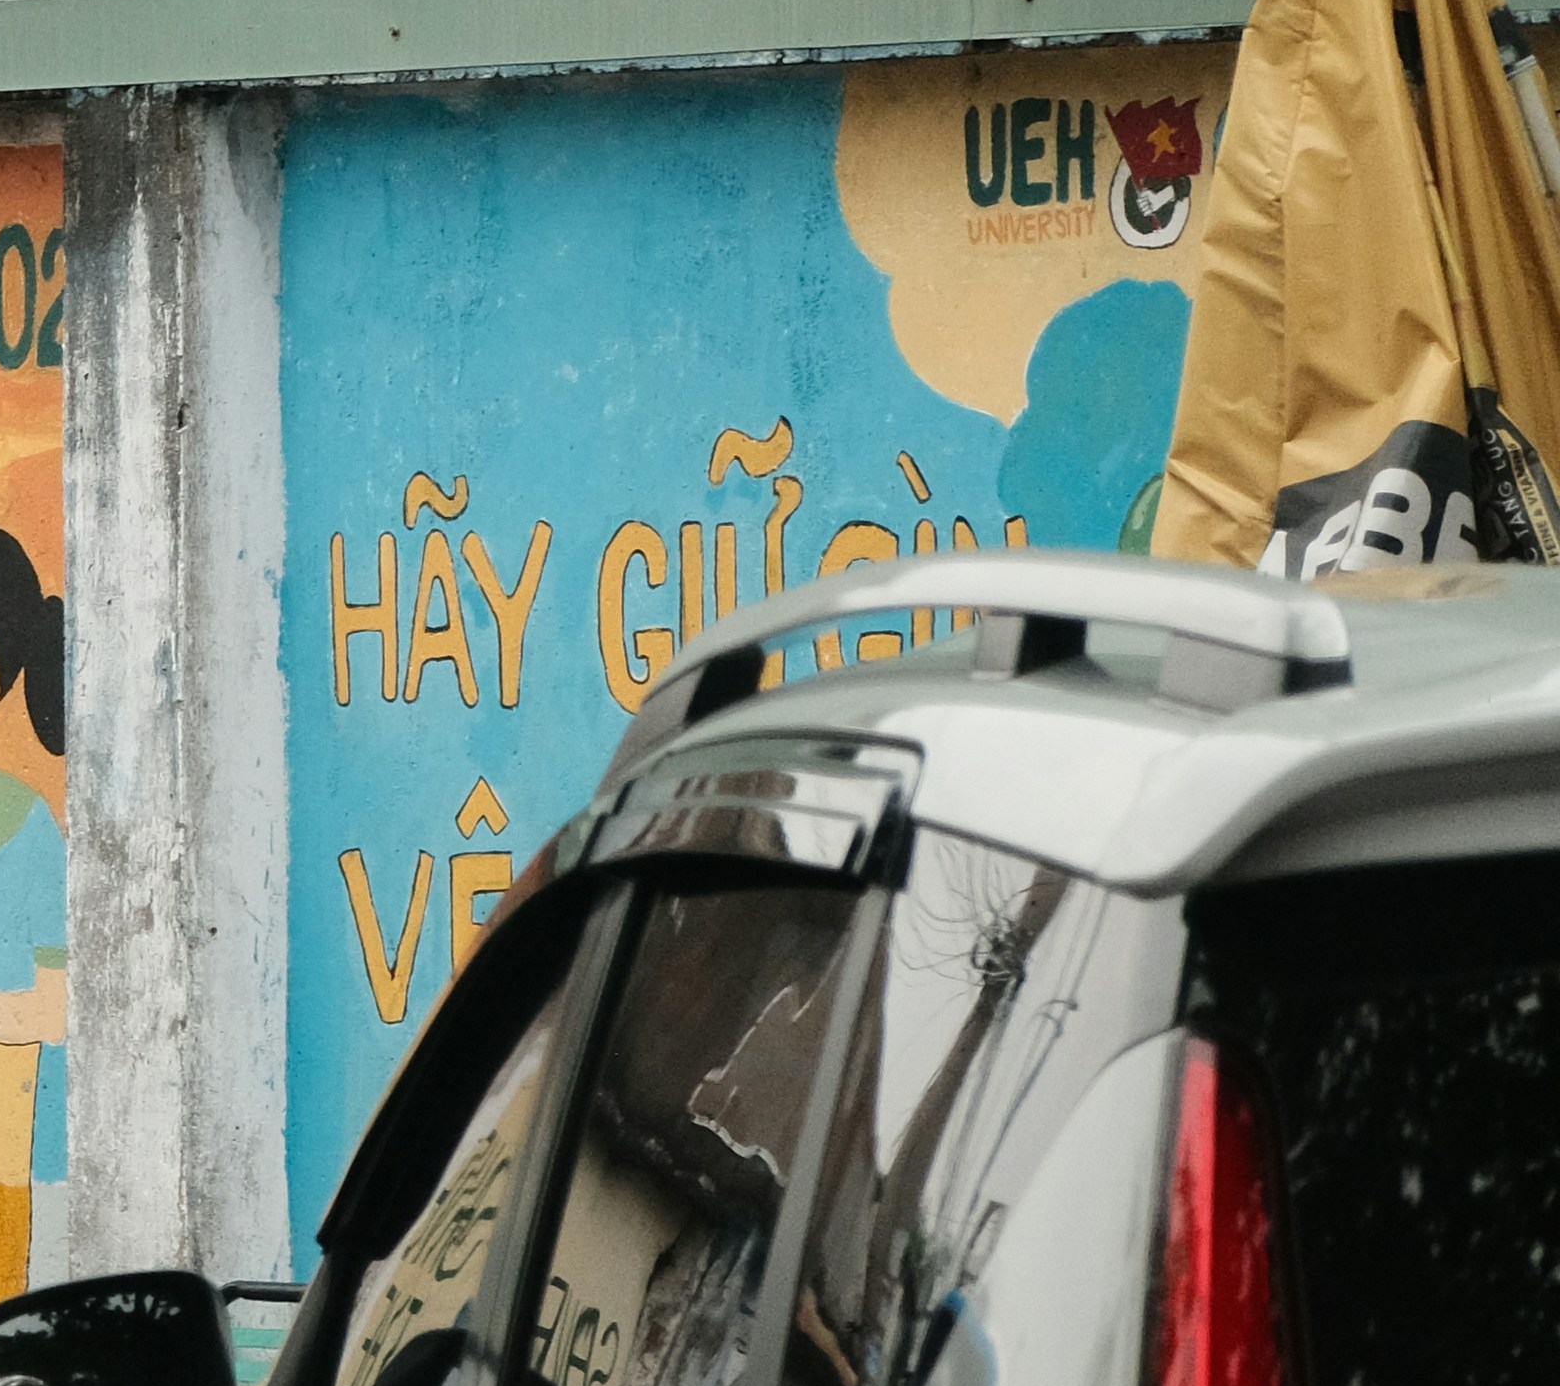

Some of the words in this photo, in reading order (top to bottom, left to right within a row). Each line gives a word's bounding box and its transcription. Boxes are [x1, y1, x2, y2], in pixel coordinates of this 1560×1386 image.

[964, 97, 1095, 208] UEH
[967, 201, 1096, 246] UNIVERSITY
[329, 470, 554, 710] HÃY
